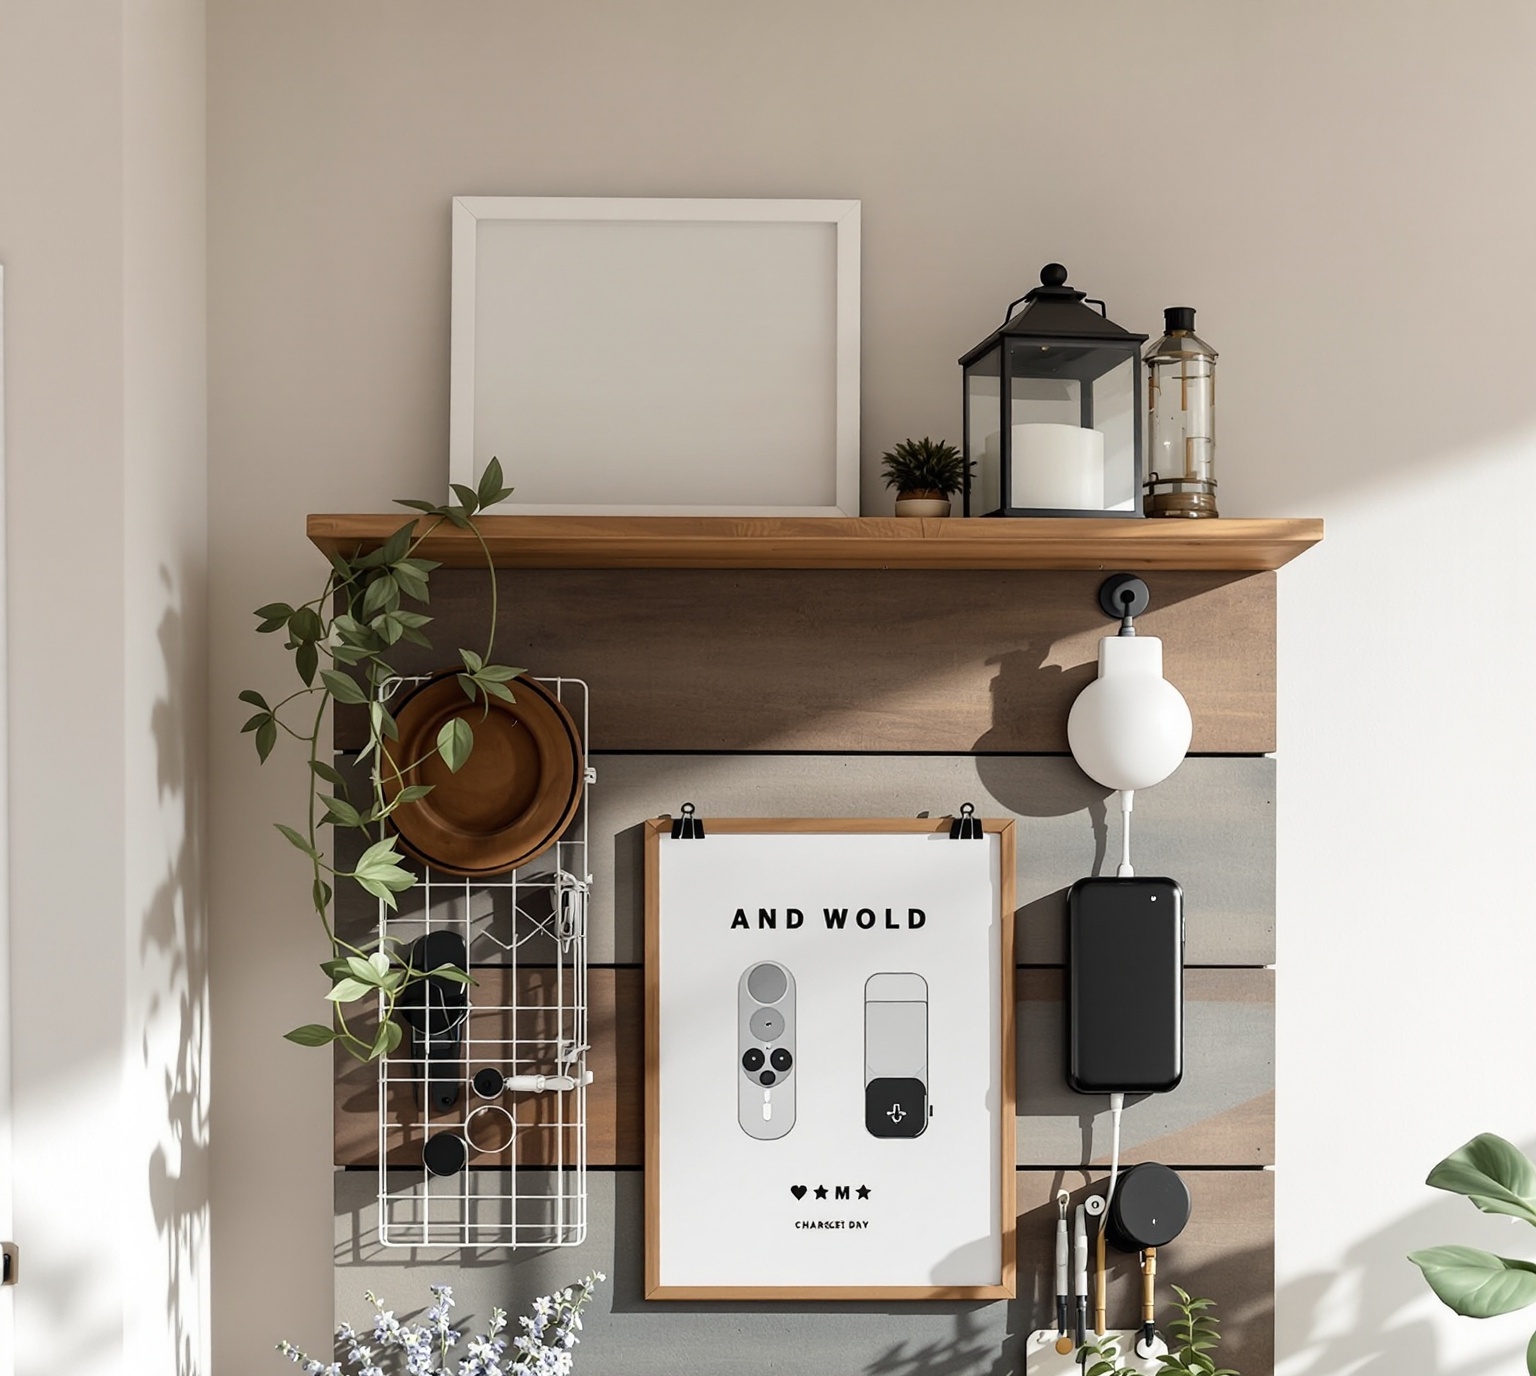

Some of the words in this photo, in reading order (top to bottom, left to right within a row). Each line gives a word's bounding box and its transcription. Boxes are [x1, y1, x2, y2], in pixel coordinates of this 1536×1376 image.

[731, 908, 804, 930] AND
[823, 908, 926, 930] WOLD
[834, 1185, 850, 1201] M
[848, 1220, 869, 1230] DAY
